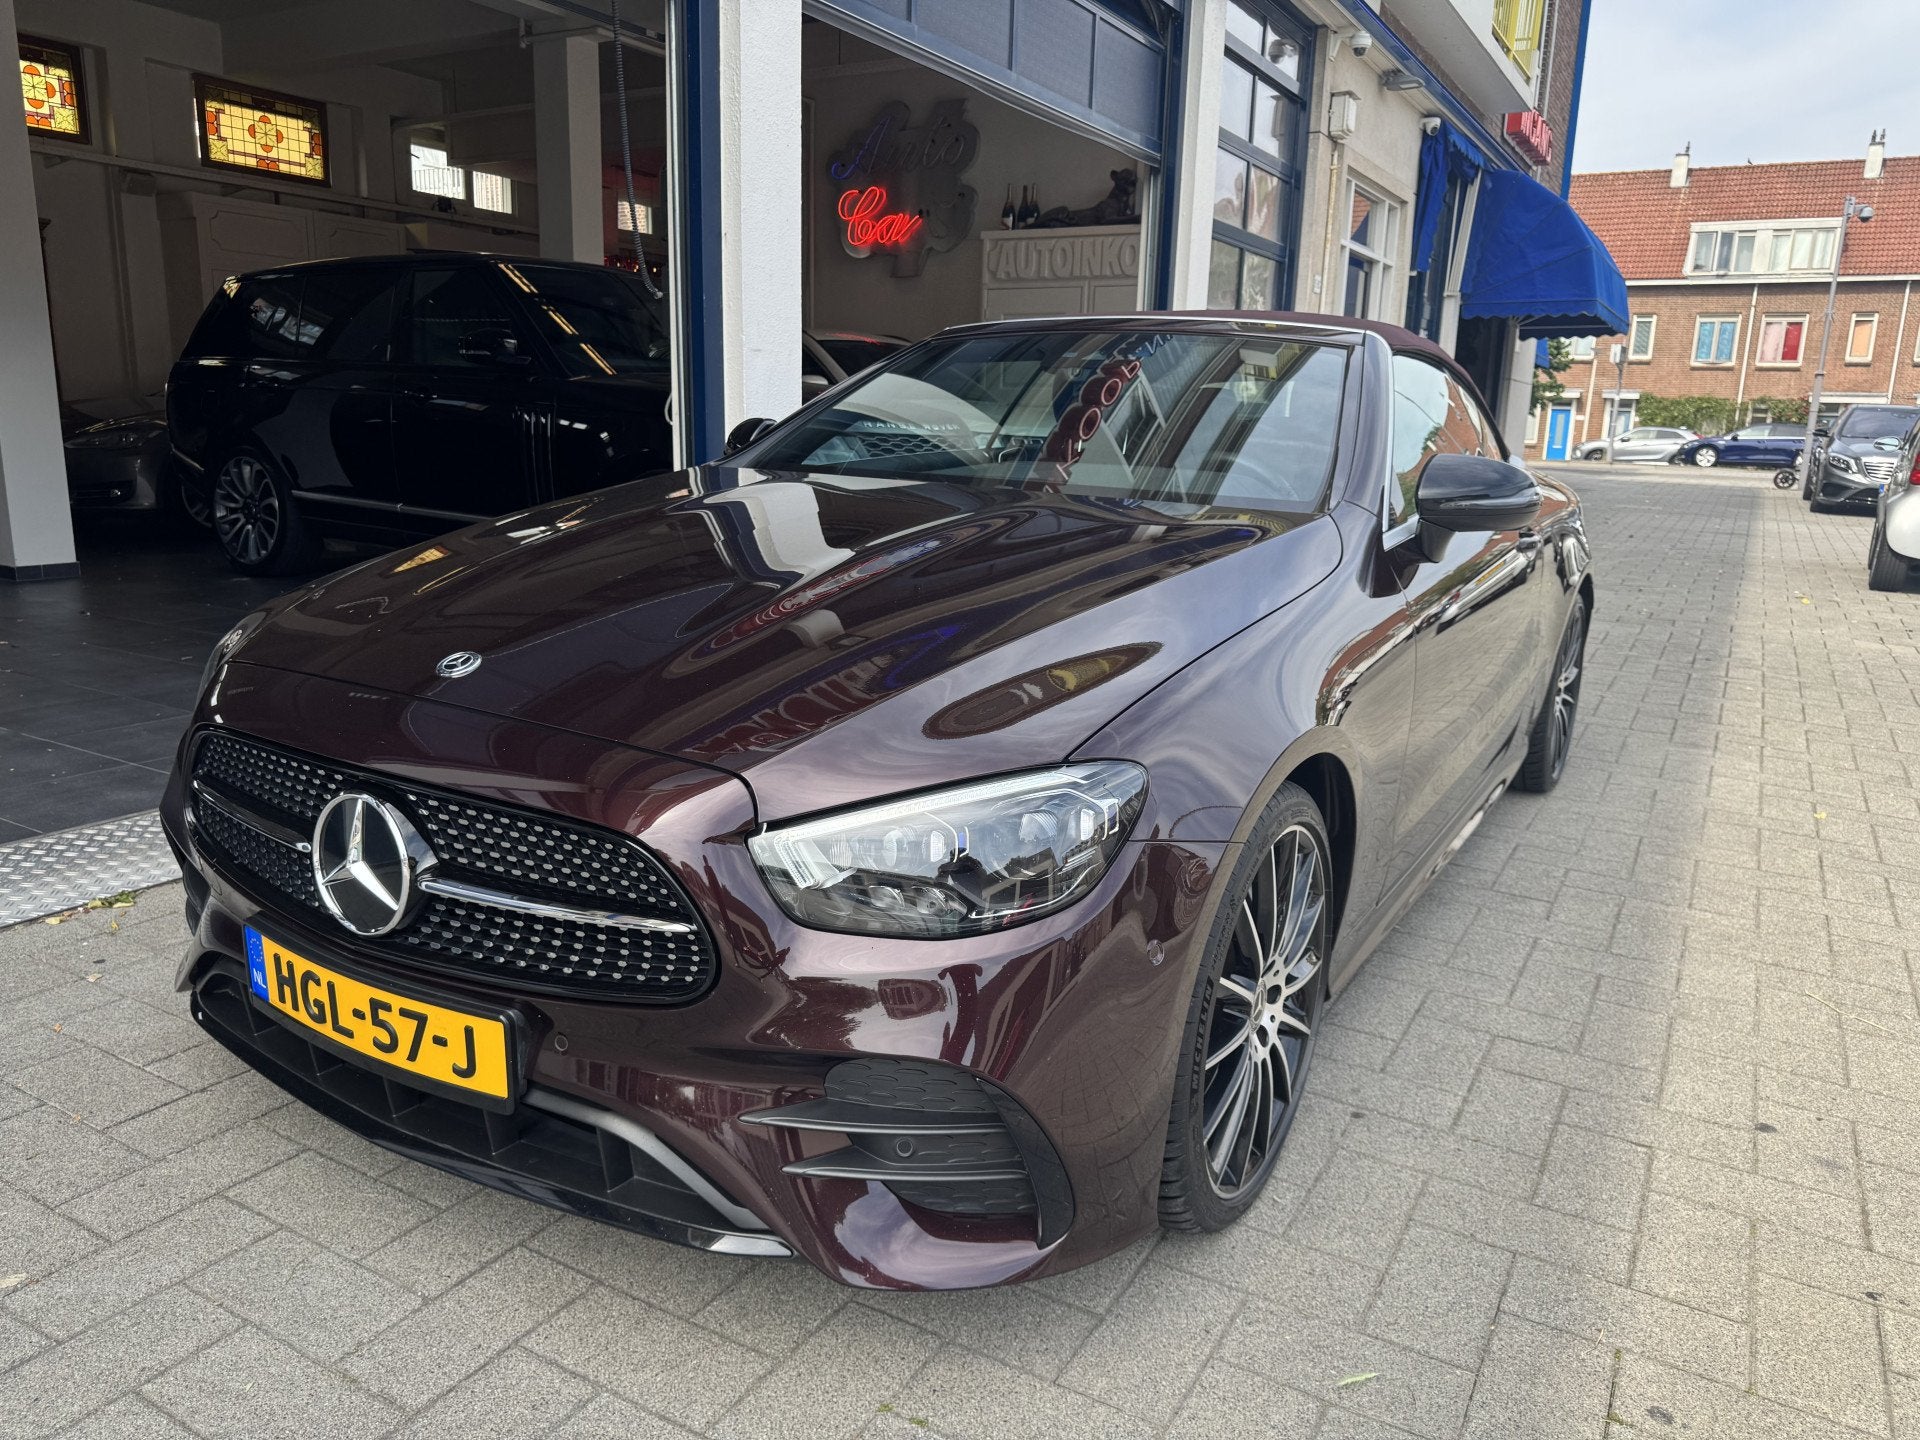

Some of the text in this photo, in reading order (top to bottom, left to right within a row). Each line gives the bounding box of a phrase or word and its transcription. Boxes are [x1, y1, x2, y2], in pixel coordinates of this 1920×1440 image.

[838, 186, 923, 246] Car
[253, 967, 267, 989] NL
[273, 953, 477, 1079] HGL-57-J
[1191, 982, 1214, 1090] MICHELIN
